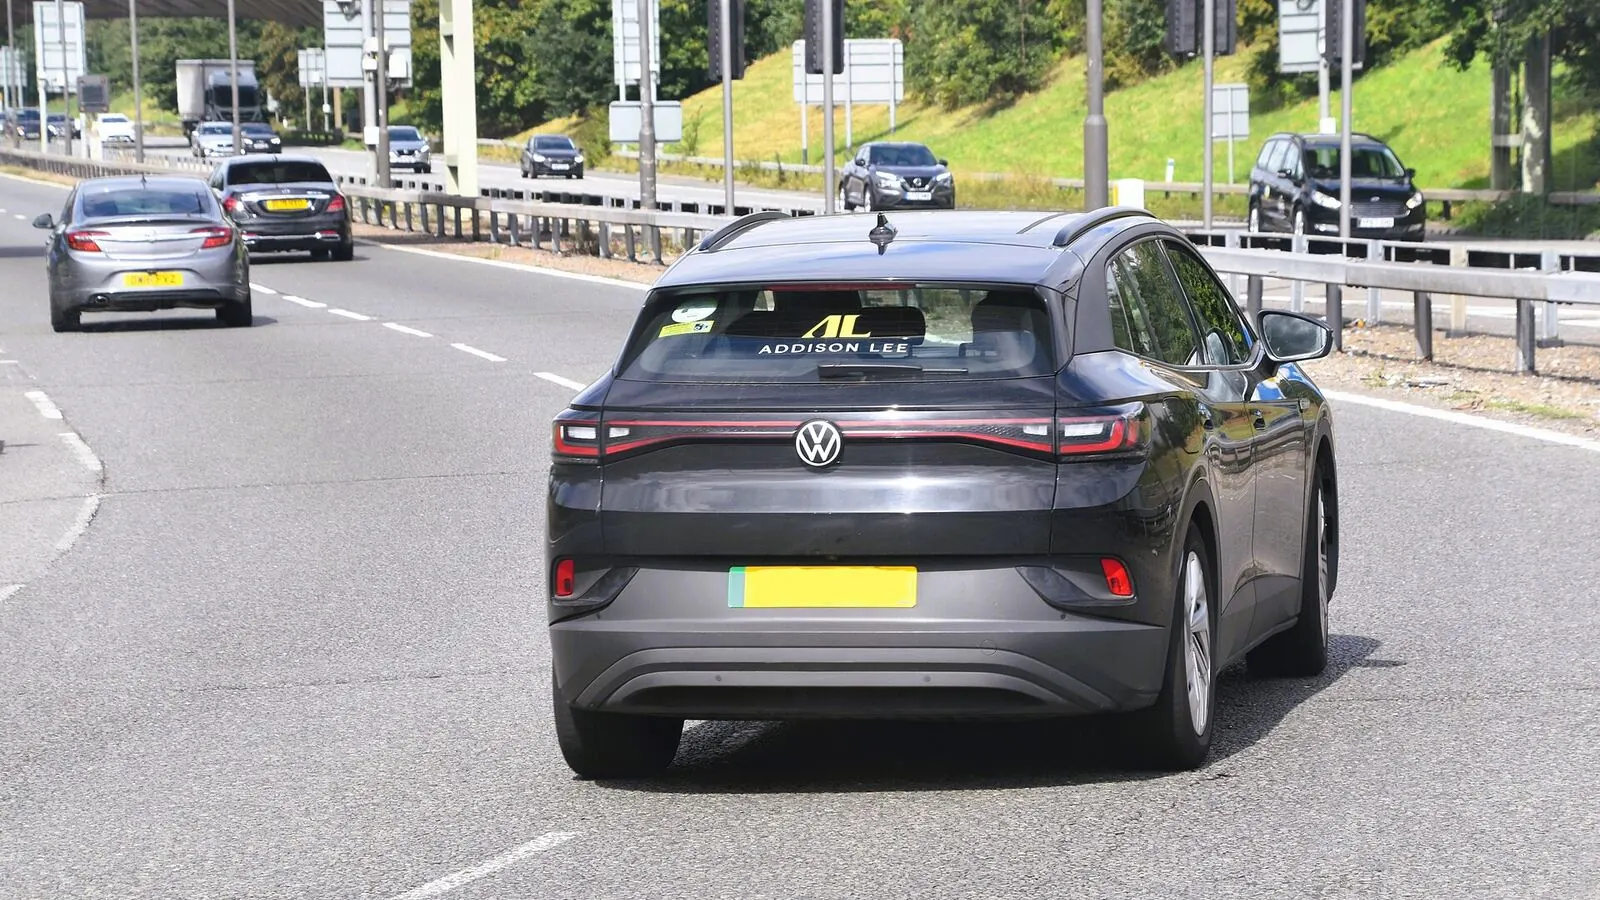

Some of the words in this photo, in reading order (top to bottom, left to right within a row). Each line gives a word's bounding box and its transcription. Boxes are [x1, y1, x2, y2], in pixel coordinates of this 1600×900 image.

[801, 314, 872, 339] AL
[758, 342, 860, 356] ADDISON
[869, 342, 909, 354] LEE
[797, 419, 840, 464] VW
